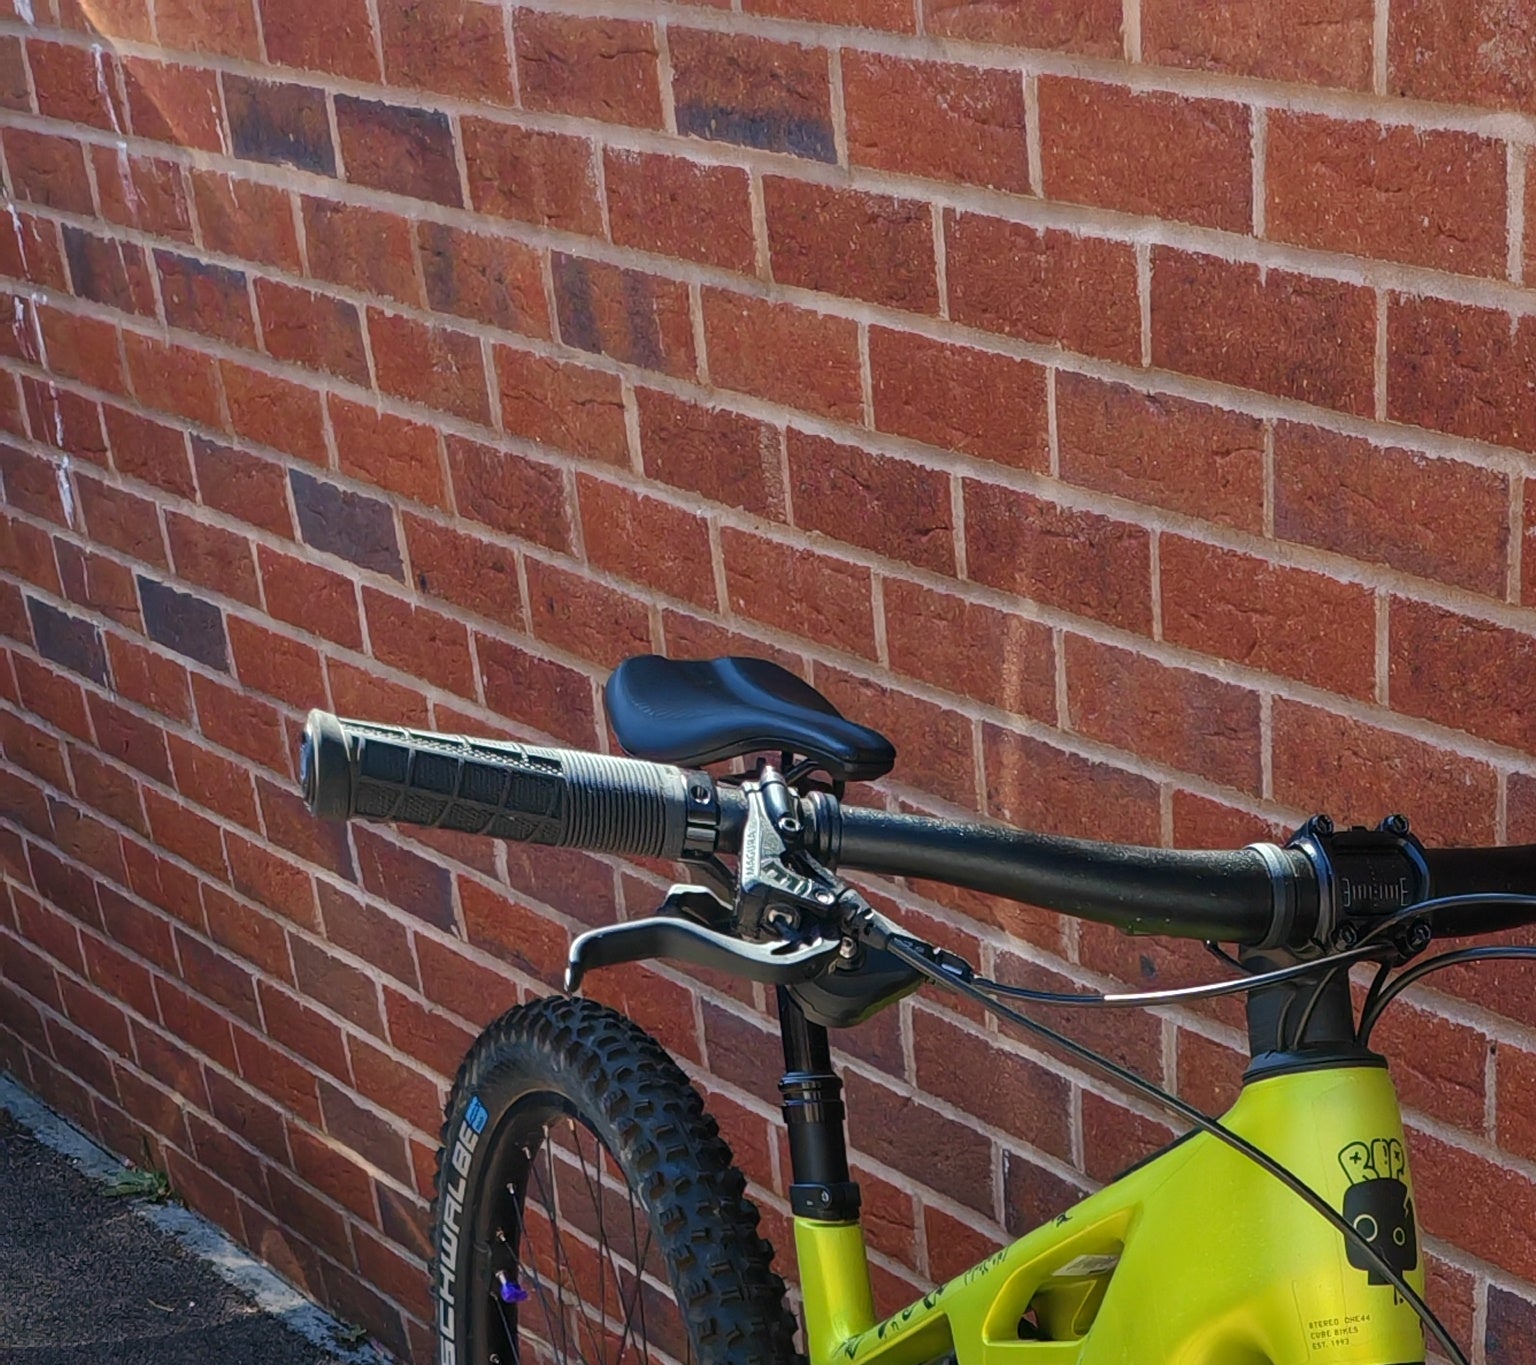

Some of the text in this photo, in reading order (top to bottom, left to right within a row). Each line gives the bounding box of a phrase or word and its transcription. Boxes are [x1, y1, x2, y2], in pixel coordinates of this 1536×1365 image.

[745, 831, 757, 876] MAGURA
[1308, 1318, 1339, 1330] STEREO
[1310, 1326, 1359, 1340] CUBE BIKES
